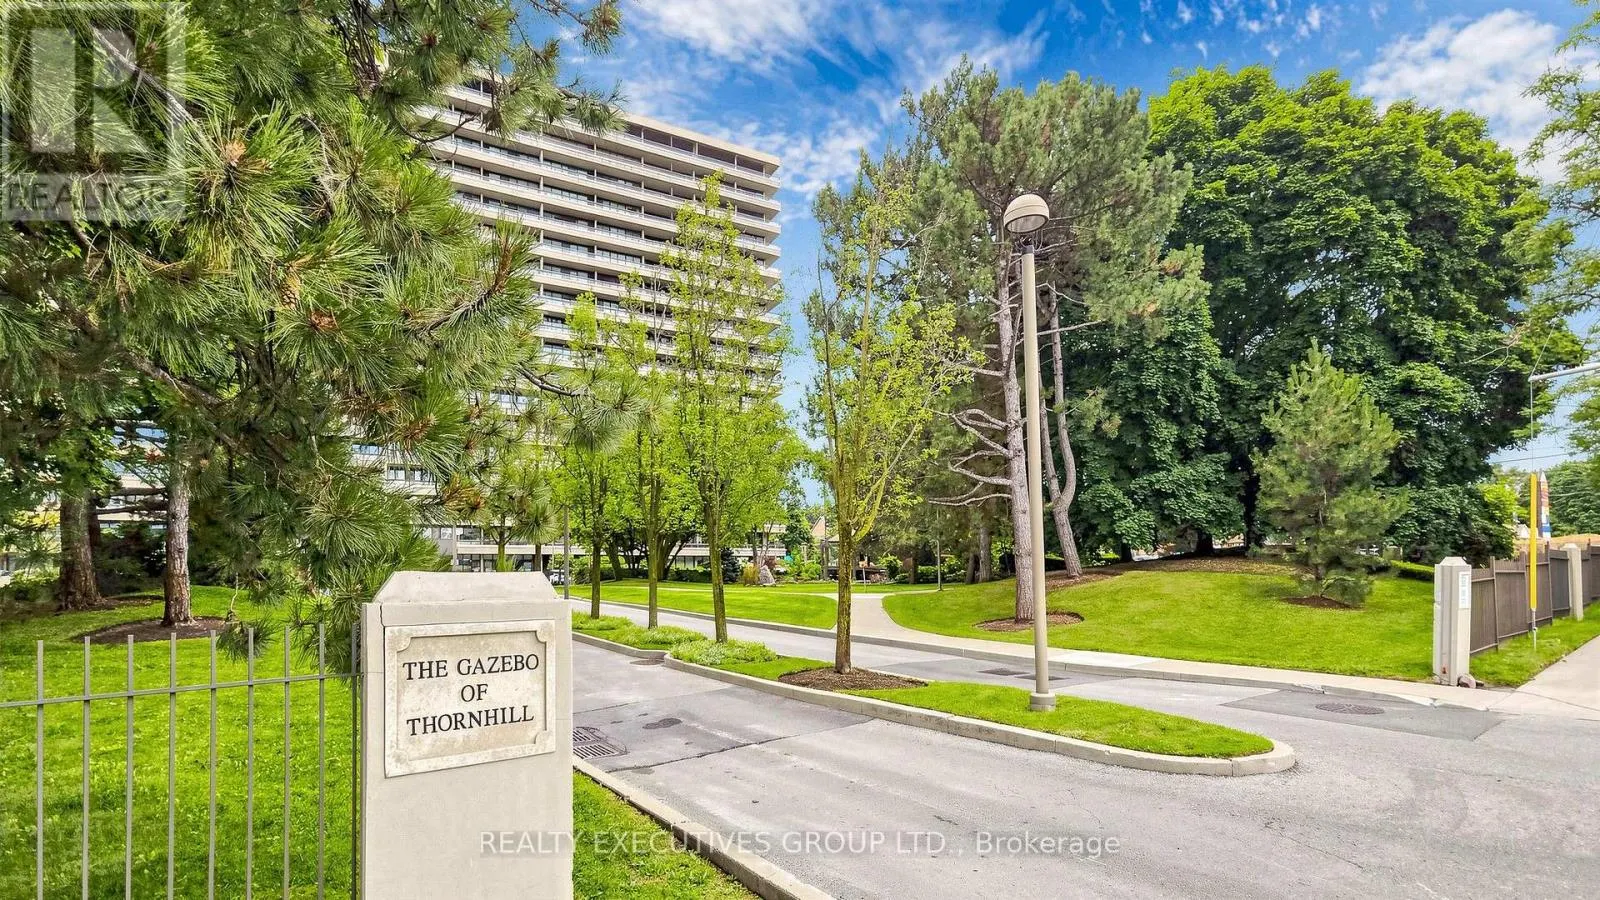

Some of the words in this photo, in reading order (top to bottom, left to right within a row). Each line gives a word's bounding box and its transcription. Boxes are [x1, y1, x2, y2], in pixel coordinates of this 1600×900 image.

[403, 659, 448, 681] THE
[457, 653, 539, 676] GAZEBO
[460, 683, 489, 703] OF
[406, 705, 535, 736] THORNHILL
